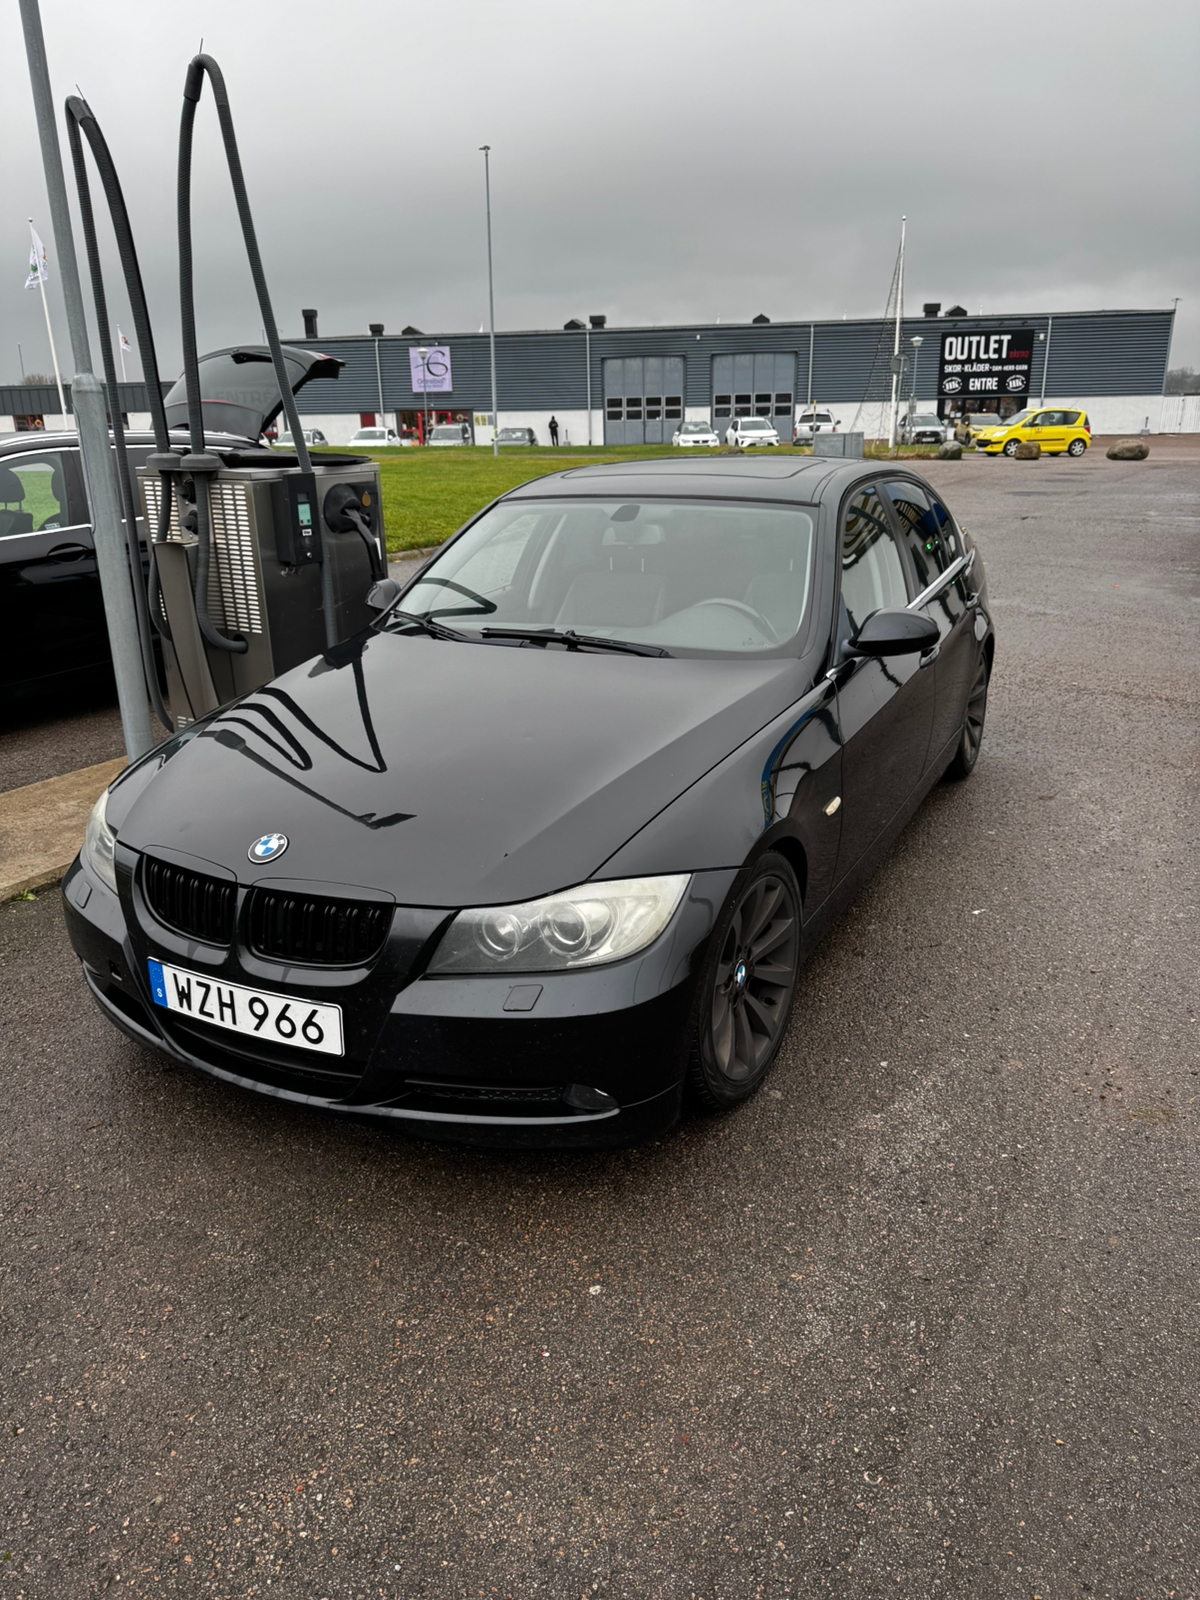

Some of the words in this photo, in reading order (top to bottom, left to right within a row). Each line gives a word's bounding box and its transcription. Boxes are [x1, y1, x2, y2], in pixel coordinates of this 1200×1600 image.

[944, 334, 1012, 361] OUTLET
[944, 364, 962, 373] SKOR
[968, 377, 998, 391] ENTRE
[156, 987, 163, 998] S
[173, 973, 238, 1026] WZH
[248, 996, 325, 1045] 966
